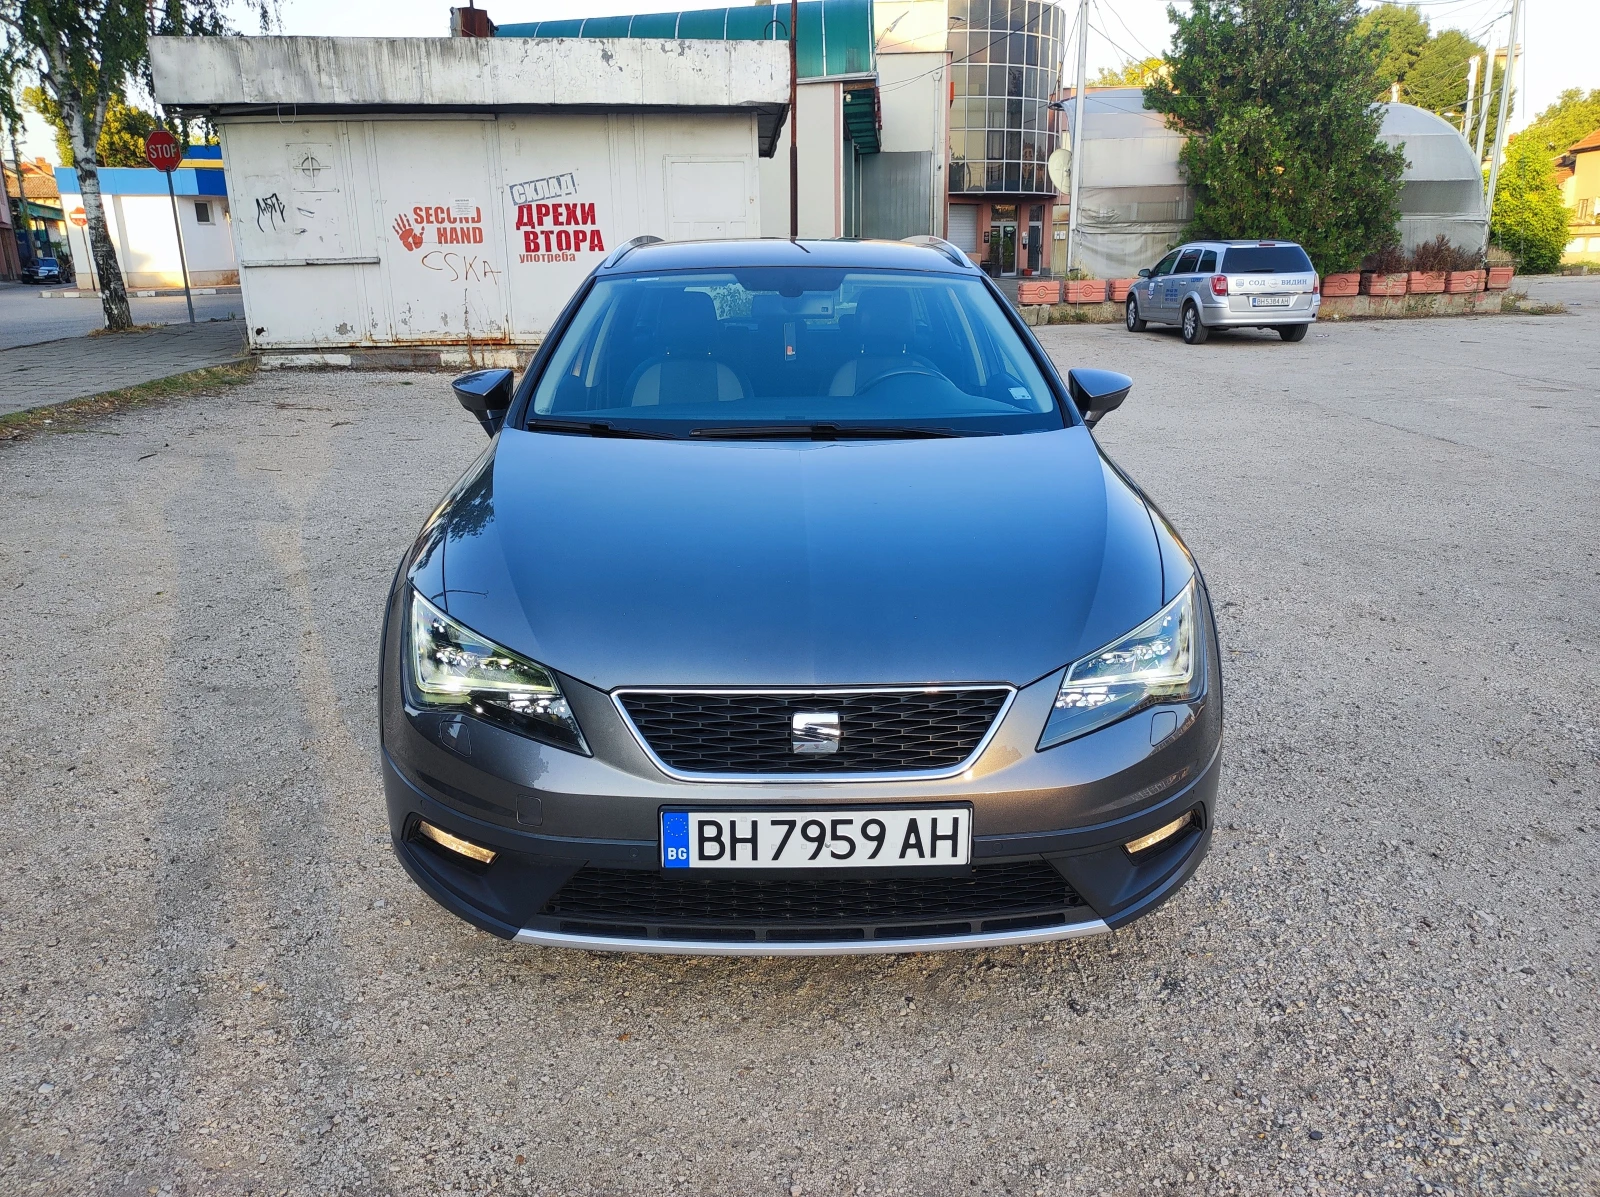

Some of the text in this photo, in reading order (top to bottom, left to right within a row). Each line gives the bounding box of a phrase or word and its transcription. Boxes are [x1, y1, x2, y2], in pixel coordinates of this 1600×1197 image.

[149, 144, 176, 158] STOP
[511, 173, 574, 205] СКЛАД
[515, 203, 596, 230] ДРЕХИ
[437, 227, 483, 244] HAND
[523, 229, 605, 253] ВТОРА
[421, 250, 501, 284] CSKA
[519, 251, 576, 263] употреба
[697, 816, 959, 861] BH 7959 AH
[667, 847, 687, 860] BG
